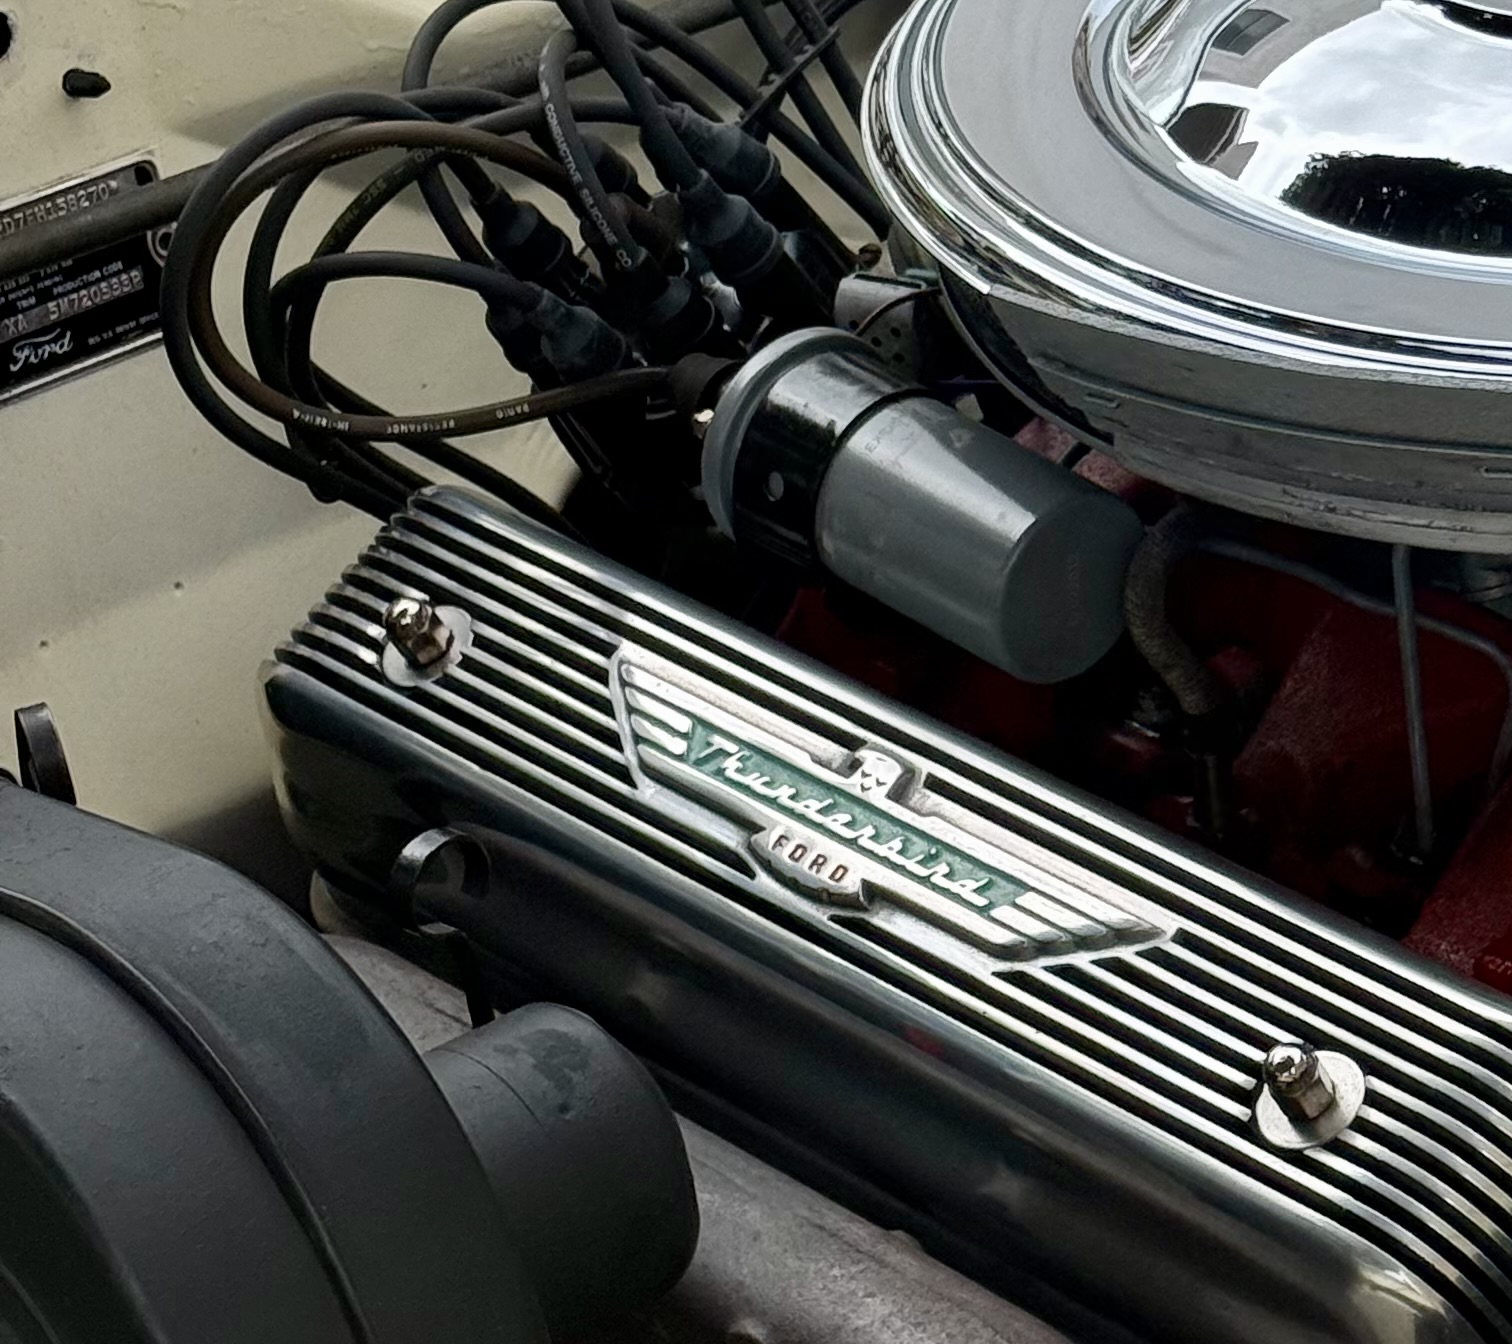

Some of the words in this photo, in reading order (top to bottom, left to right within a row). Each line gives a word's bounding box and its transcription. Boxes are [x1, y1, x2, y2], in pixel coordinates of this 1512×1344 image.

[579, 187, 619, 246] SILICONE
[52, 270, 102, 296] PRODUCTION
[9, 327, 74, 373] Ford
[696, 732, 993, 908] Thunderbird
[770, 832, 851, 885] FORD
